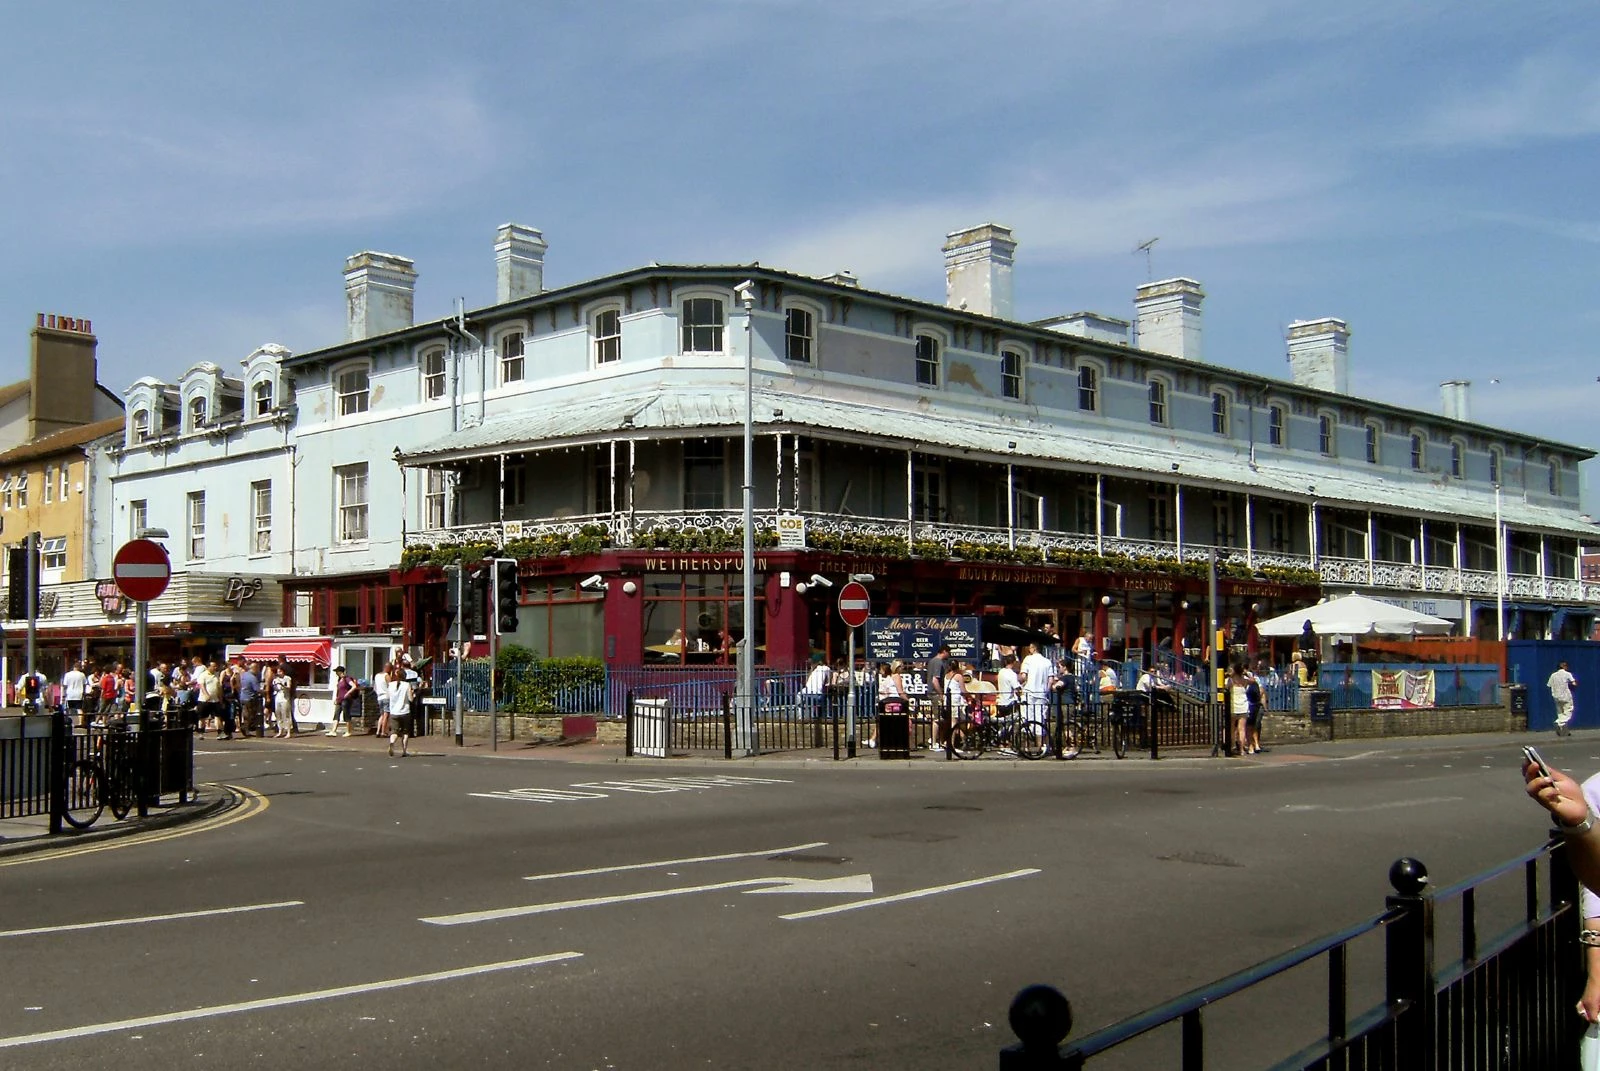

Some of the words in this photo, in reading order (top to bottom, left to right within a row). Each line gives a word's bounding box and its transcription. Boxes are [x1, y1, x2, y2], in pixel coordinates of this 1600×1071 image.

[780, 519, 802, 529] COE
[645, 558, 767, 571] WETHERSPON
[819, 562, 847, 573] FREE
[884, 618, 912, 630] Moon
[921, 618, 959, 632] Starfish
